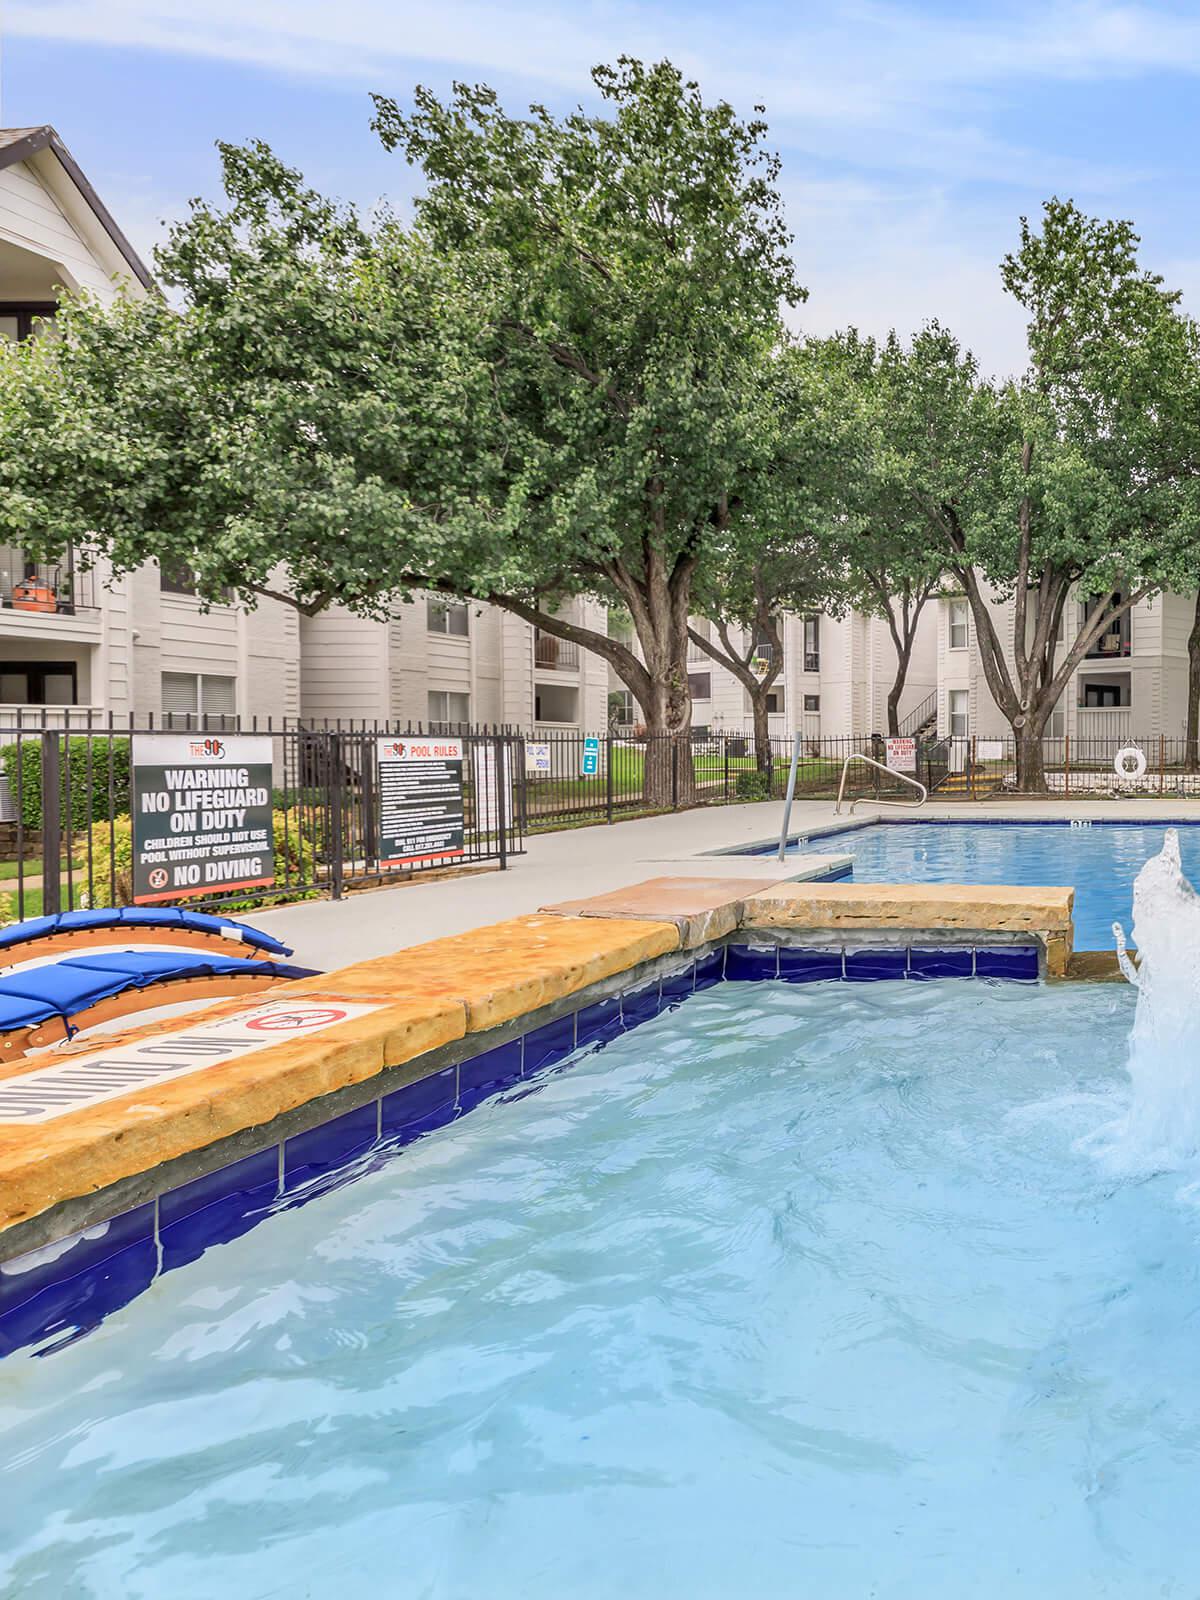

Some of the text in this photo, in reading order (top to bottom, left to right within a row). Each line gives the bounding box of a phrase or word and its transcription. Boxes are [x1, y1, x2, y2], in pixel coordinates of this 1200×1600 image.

[411, 745, 458, 757] POOL RULES
[165, 768, 249, 790] WARNING
[142, 788, 268, 813] NO LIFEGUARD
[170, 809, 247, 833] ON DUTY
[144, 829, 267, 850] CHILDREN SHOULD NOT USE
[141, 852, 168, 864] POOL
[169, 847, 210, 860] WITHOUT
[174, 857, 262, 886] NO DIVING
[137, 1035, 268, 1056] NO
